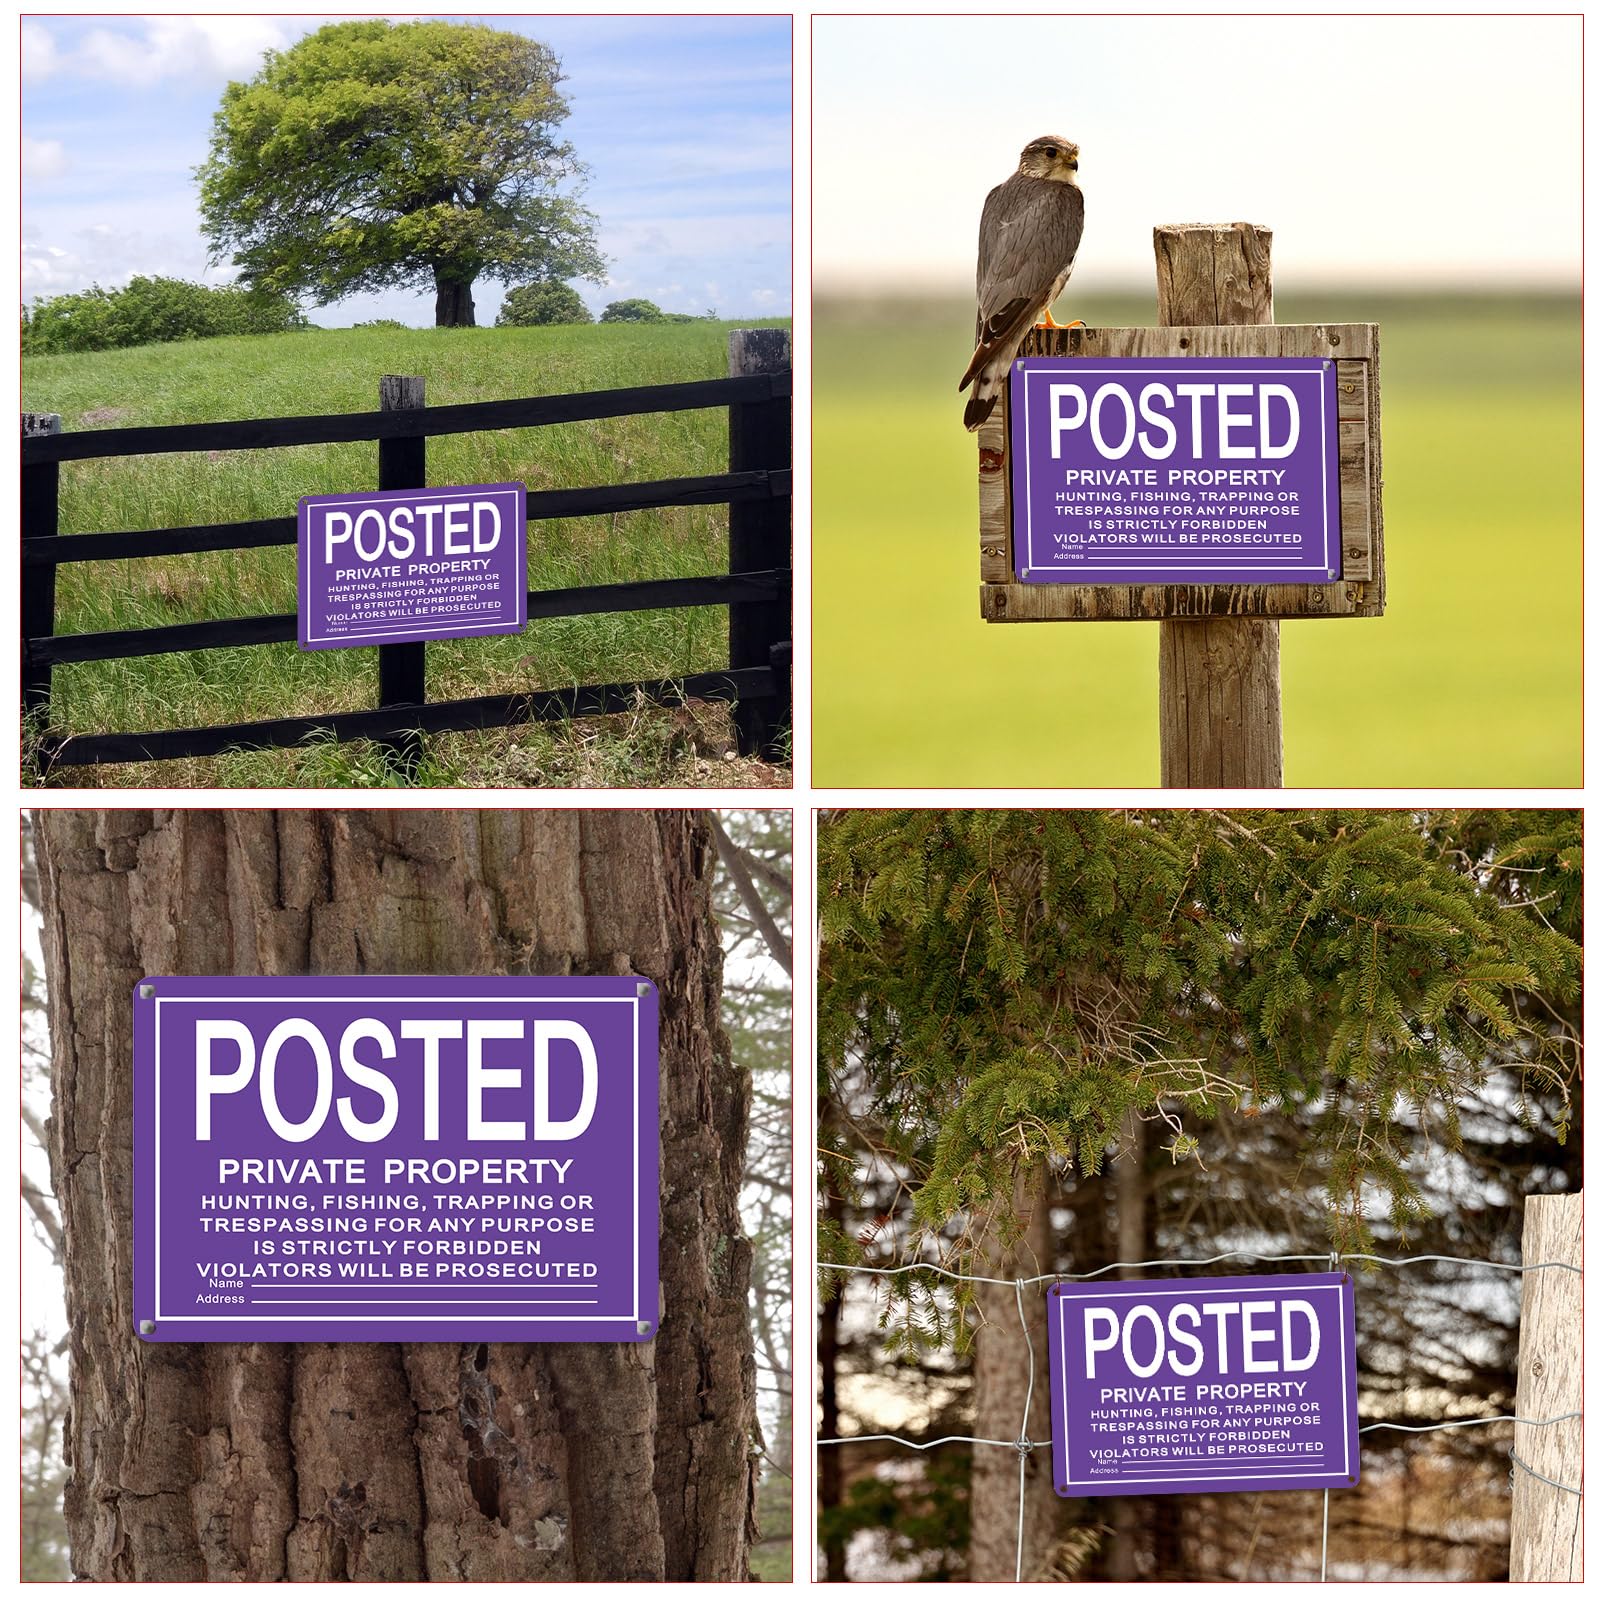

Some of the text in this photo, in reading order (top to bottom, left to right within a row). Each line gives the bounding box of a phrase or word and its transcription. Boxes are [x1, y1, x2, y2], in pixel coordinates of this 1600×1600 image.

[1049, 382, 1300, 460] POSTED
[1066, 469, 1285, 486] PRIVATE PROPERTY
[1056, 492, 1299, 503] HUNTING, FISHING, TRAPPING OR
[1055, 506, 1300, 516] TRESPASSING FOR ANY PURPOSE
[325, 501, 502, 564] POSTED
[1089, 520, 1267, 530] IS STRICTLY FORBIDDEN
[1054, 533, 1302, 544] VIOLATORS WILL BE PROSECUTED
[336, 559, 491, 581] PRIVATE PROPERTY
[328, 573, 499, 593] HUNTING, FISHING, TRAPPING OR
[328, 583, 500, 602] TRESPASSING FOR ANY PURPOSE
[417, 594, 477, 604] FORBIDDEN
[326, 611, 386, 621] VIOLATORS
[431, 601, 501, 613] PROSECUTED
[195, 1017, 599, 1143] POSTED
[219, 1159, 573, 1184] PRIVATE PROPERTY
[201, 1195, 594, 1213] HUNTING, FISHING, TRAPPING OR
[200, 1218, 595, 1233] TRESPASSING FOR ANY PURPOSE
[253, 1240, 541, 1256] IS STRICTLY FORBIDDEN
[197, 1263, 598, 1278] VIOLATORS WILL BE PROSECUTED
[209, 1279, 244, 1289] Name
[196, 1294, 245, 1304] Address
[1084, 1300, 1320, 1379] POSTED
[1101, 1382, 1307, 1403] PRIVATE PROPERTY
[1091, 1402, 1320, 1419] HUNTING, FISHING, TRAPPING OR
[1091, 1415, 1320, 1432] TRESPASSING FOR ANY PURPOSE
[1122, 1430, 1290, 1444] IS STRICTLY FORBIDDEN
[1089, 1442, 1324, 1459] VIOLATORS WILL BE PROSECUTED
